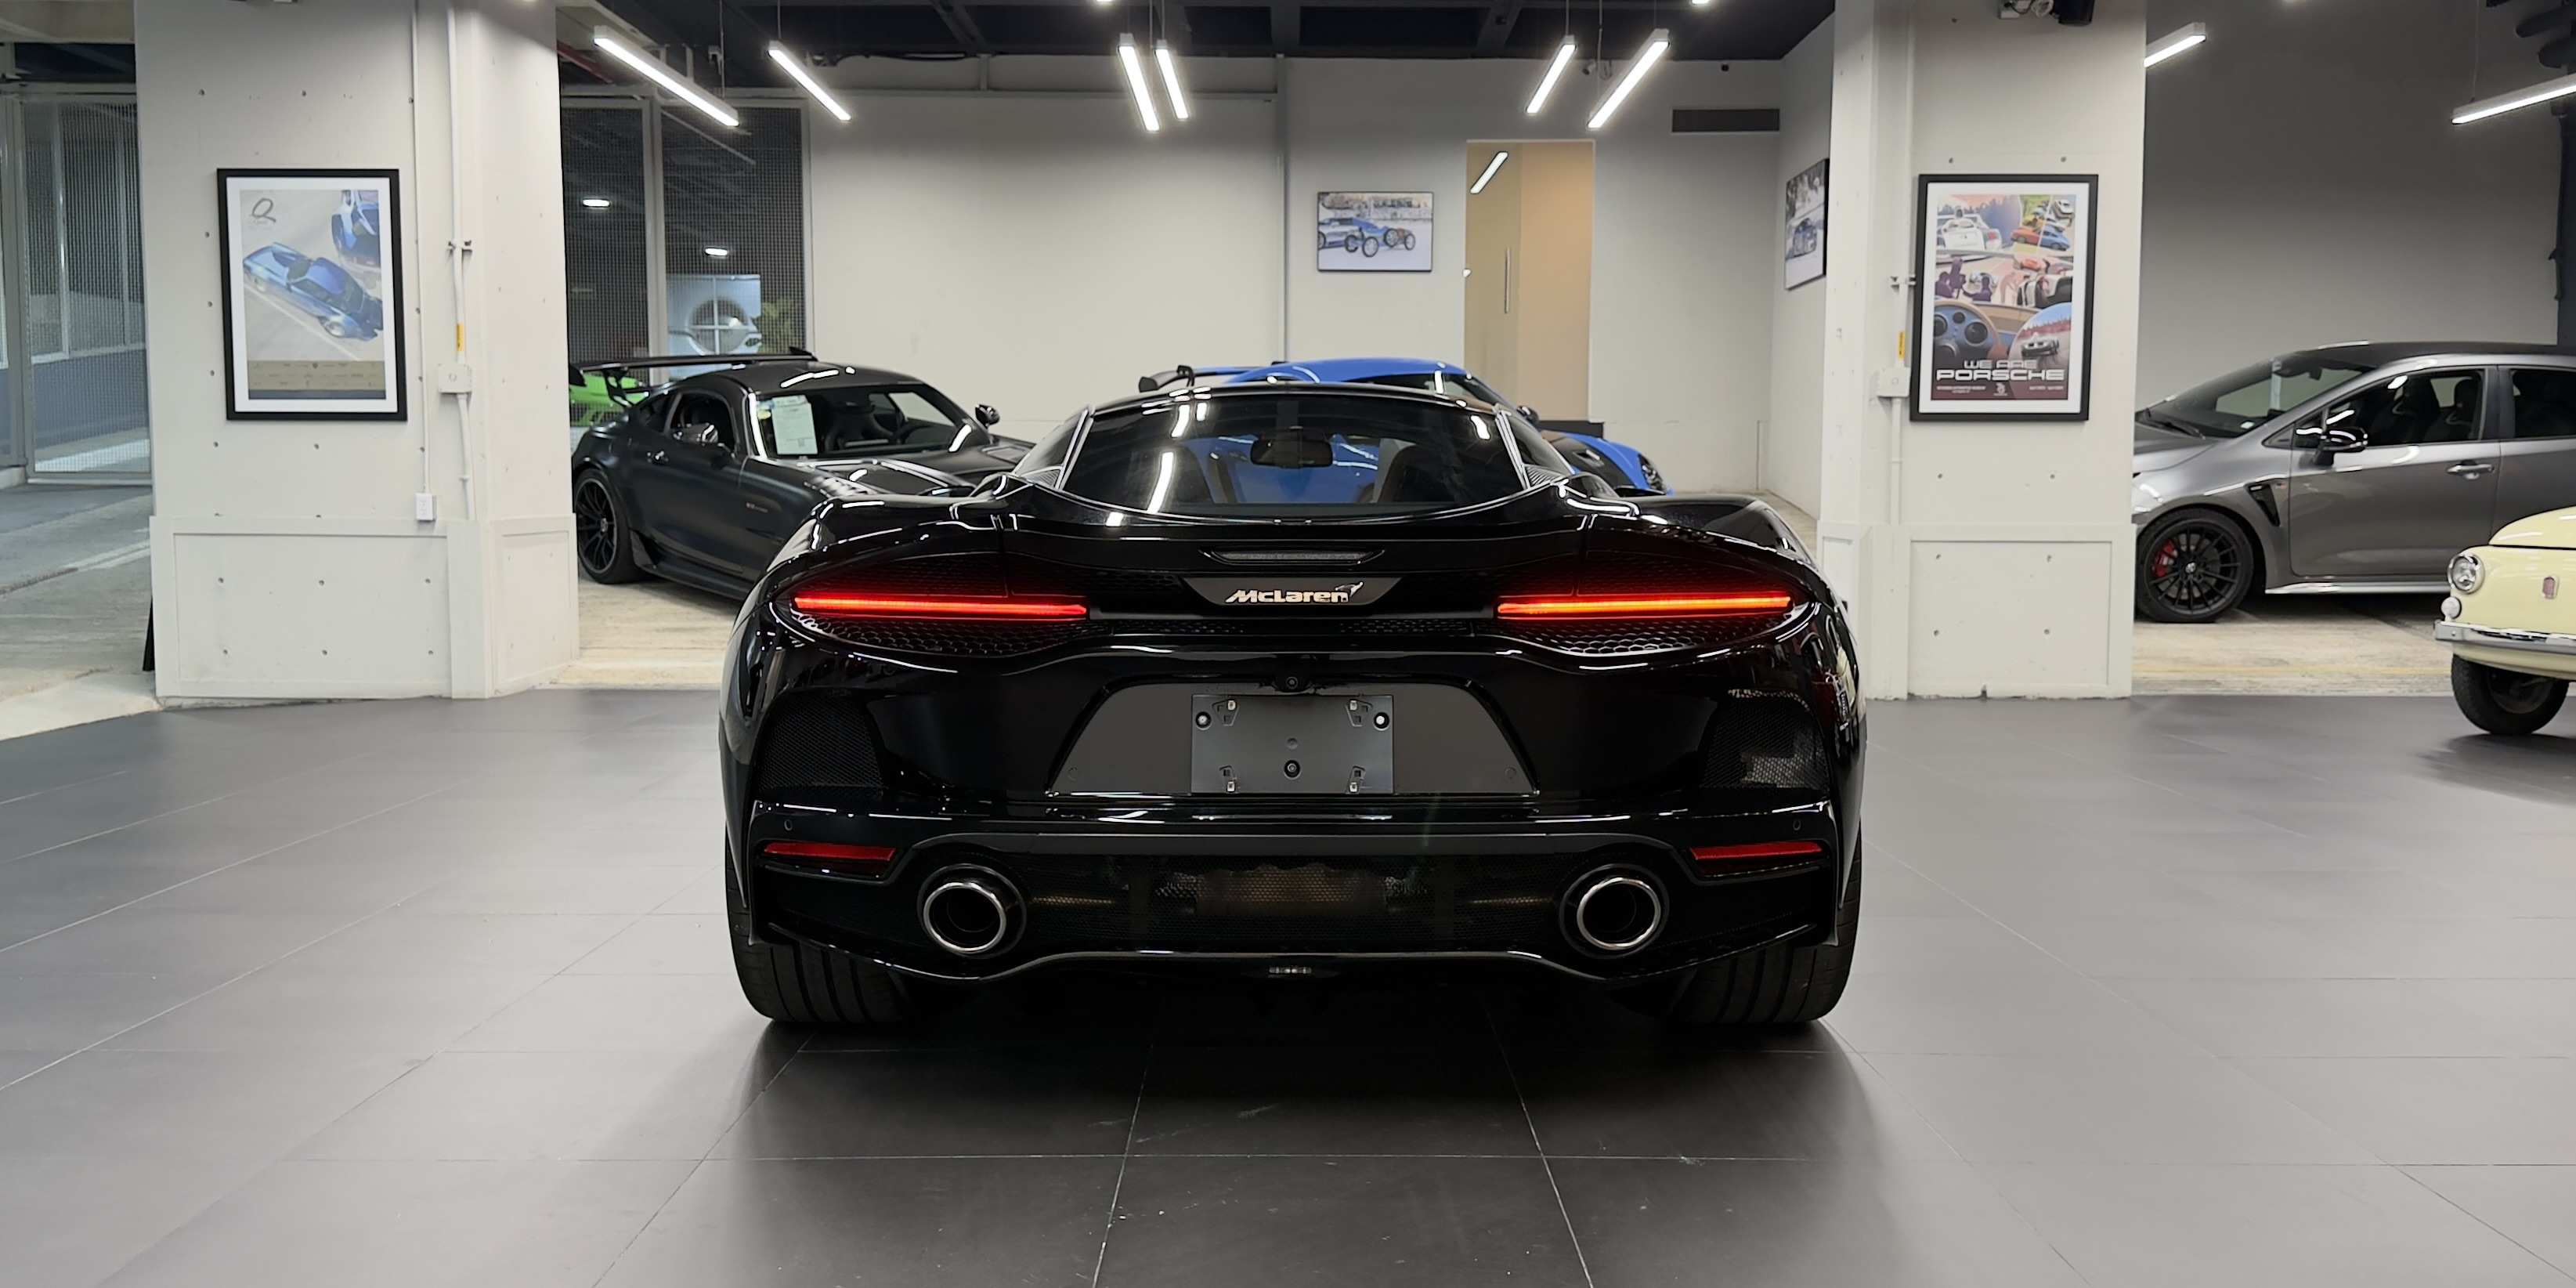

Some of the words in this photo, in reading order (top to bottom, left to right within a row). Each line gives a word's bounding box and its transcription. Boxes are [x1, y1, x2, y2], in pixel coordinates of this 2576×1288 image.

[1964, 360, 1993, 369] WE
[1996, 359, 2037, 369] ARE
[1936, 369, 2065, 381] PORSCHE
[1225, 589, 1349, 603] McLaren
